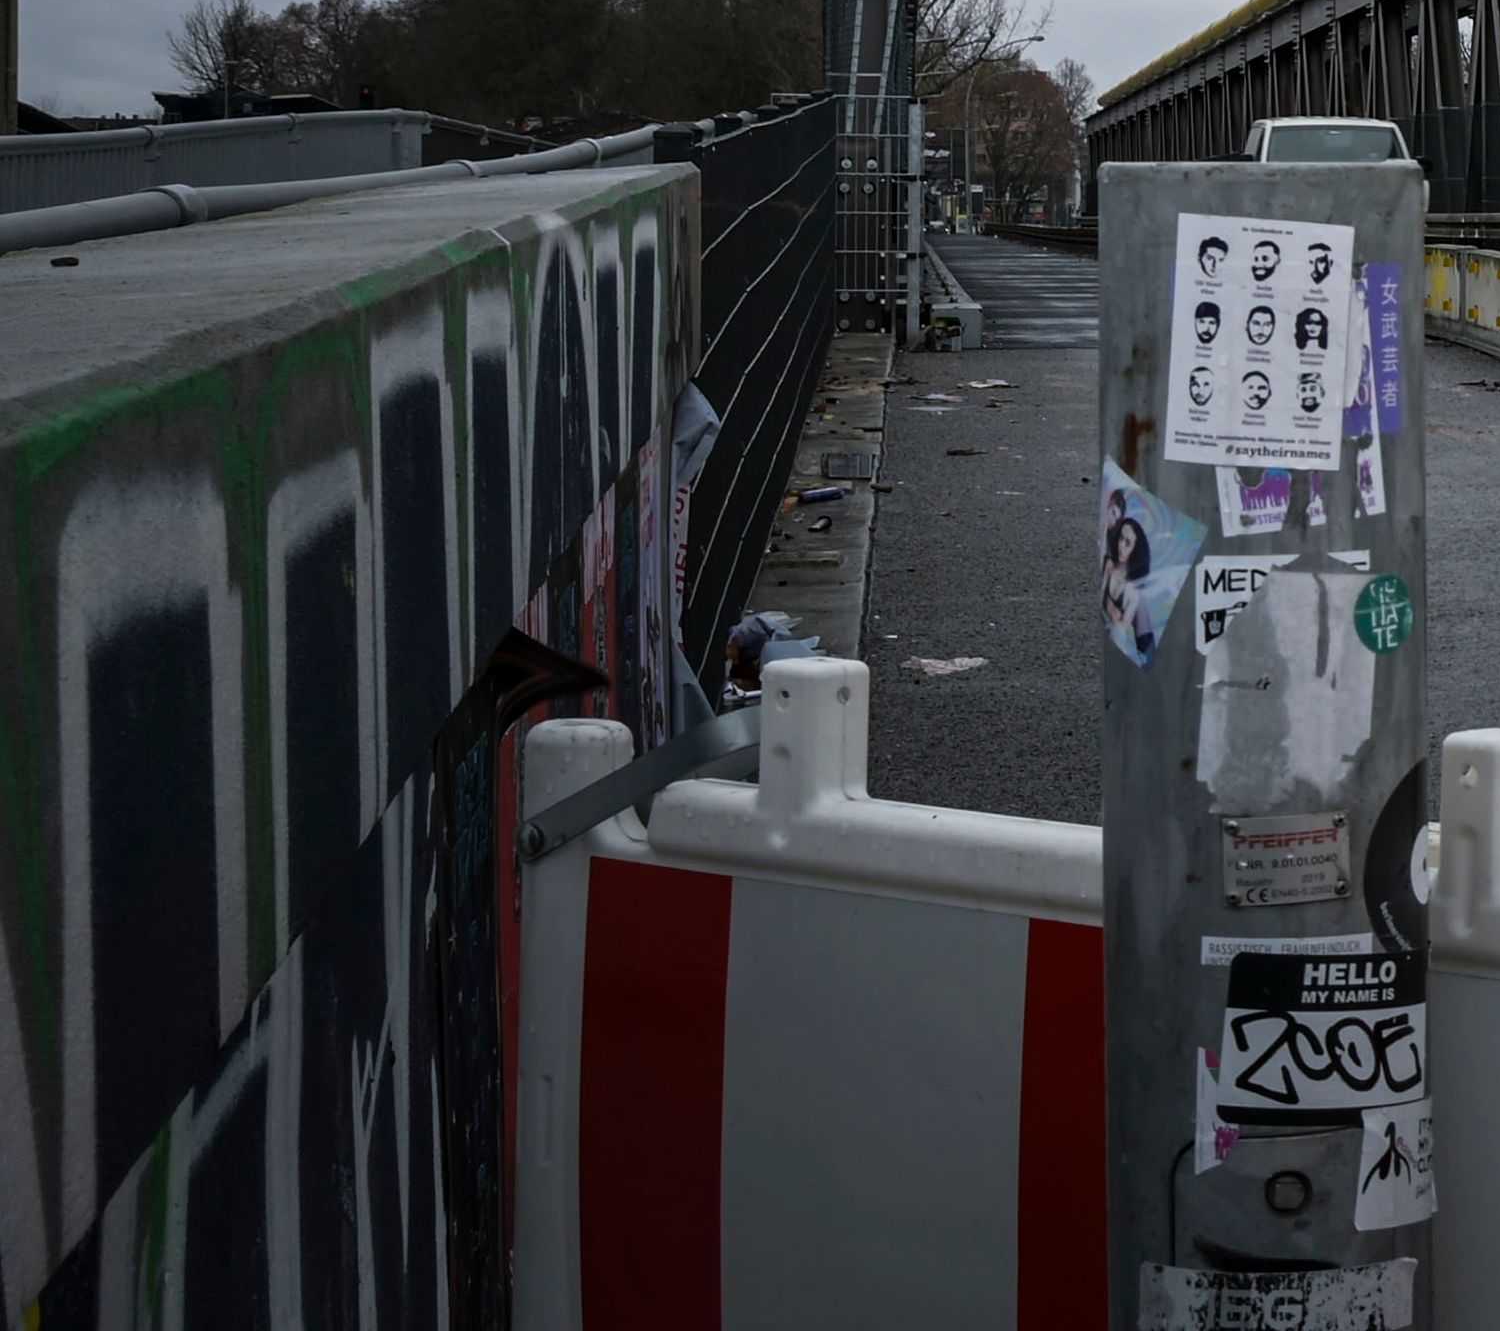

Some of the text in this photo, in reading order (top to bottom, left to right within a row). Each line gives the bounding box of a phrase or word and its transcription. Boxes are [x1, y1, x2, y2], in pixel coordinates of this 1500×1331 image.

[1225, 444, 1331, 461] #saytheirnames
[1235, 859, 1266, 871] LNR.
[1301, 872, 1325, 884] 2019
[1303, 960, 1396, 986] HELLO
[1301, 987, 1395, 1004] MY NAME IS
